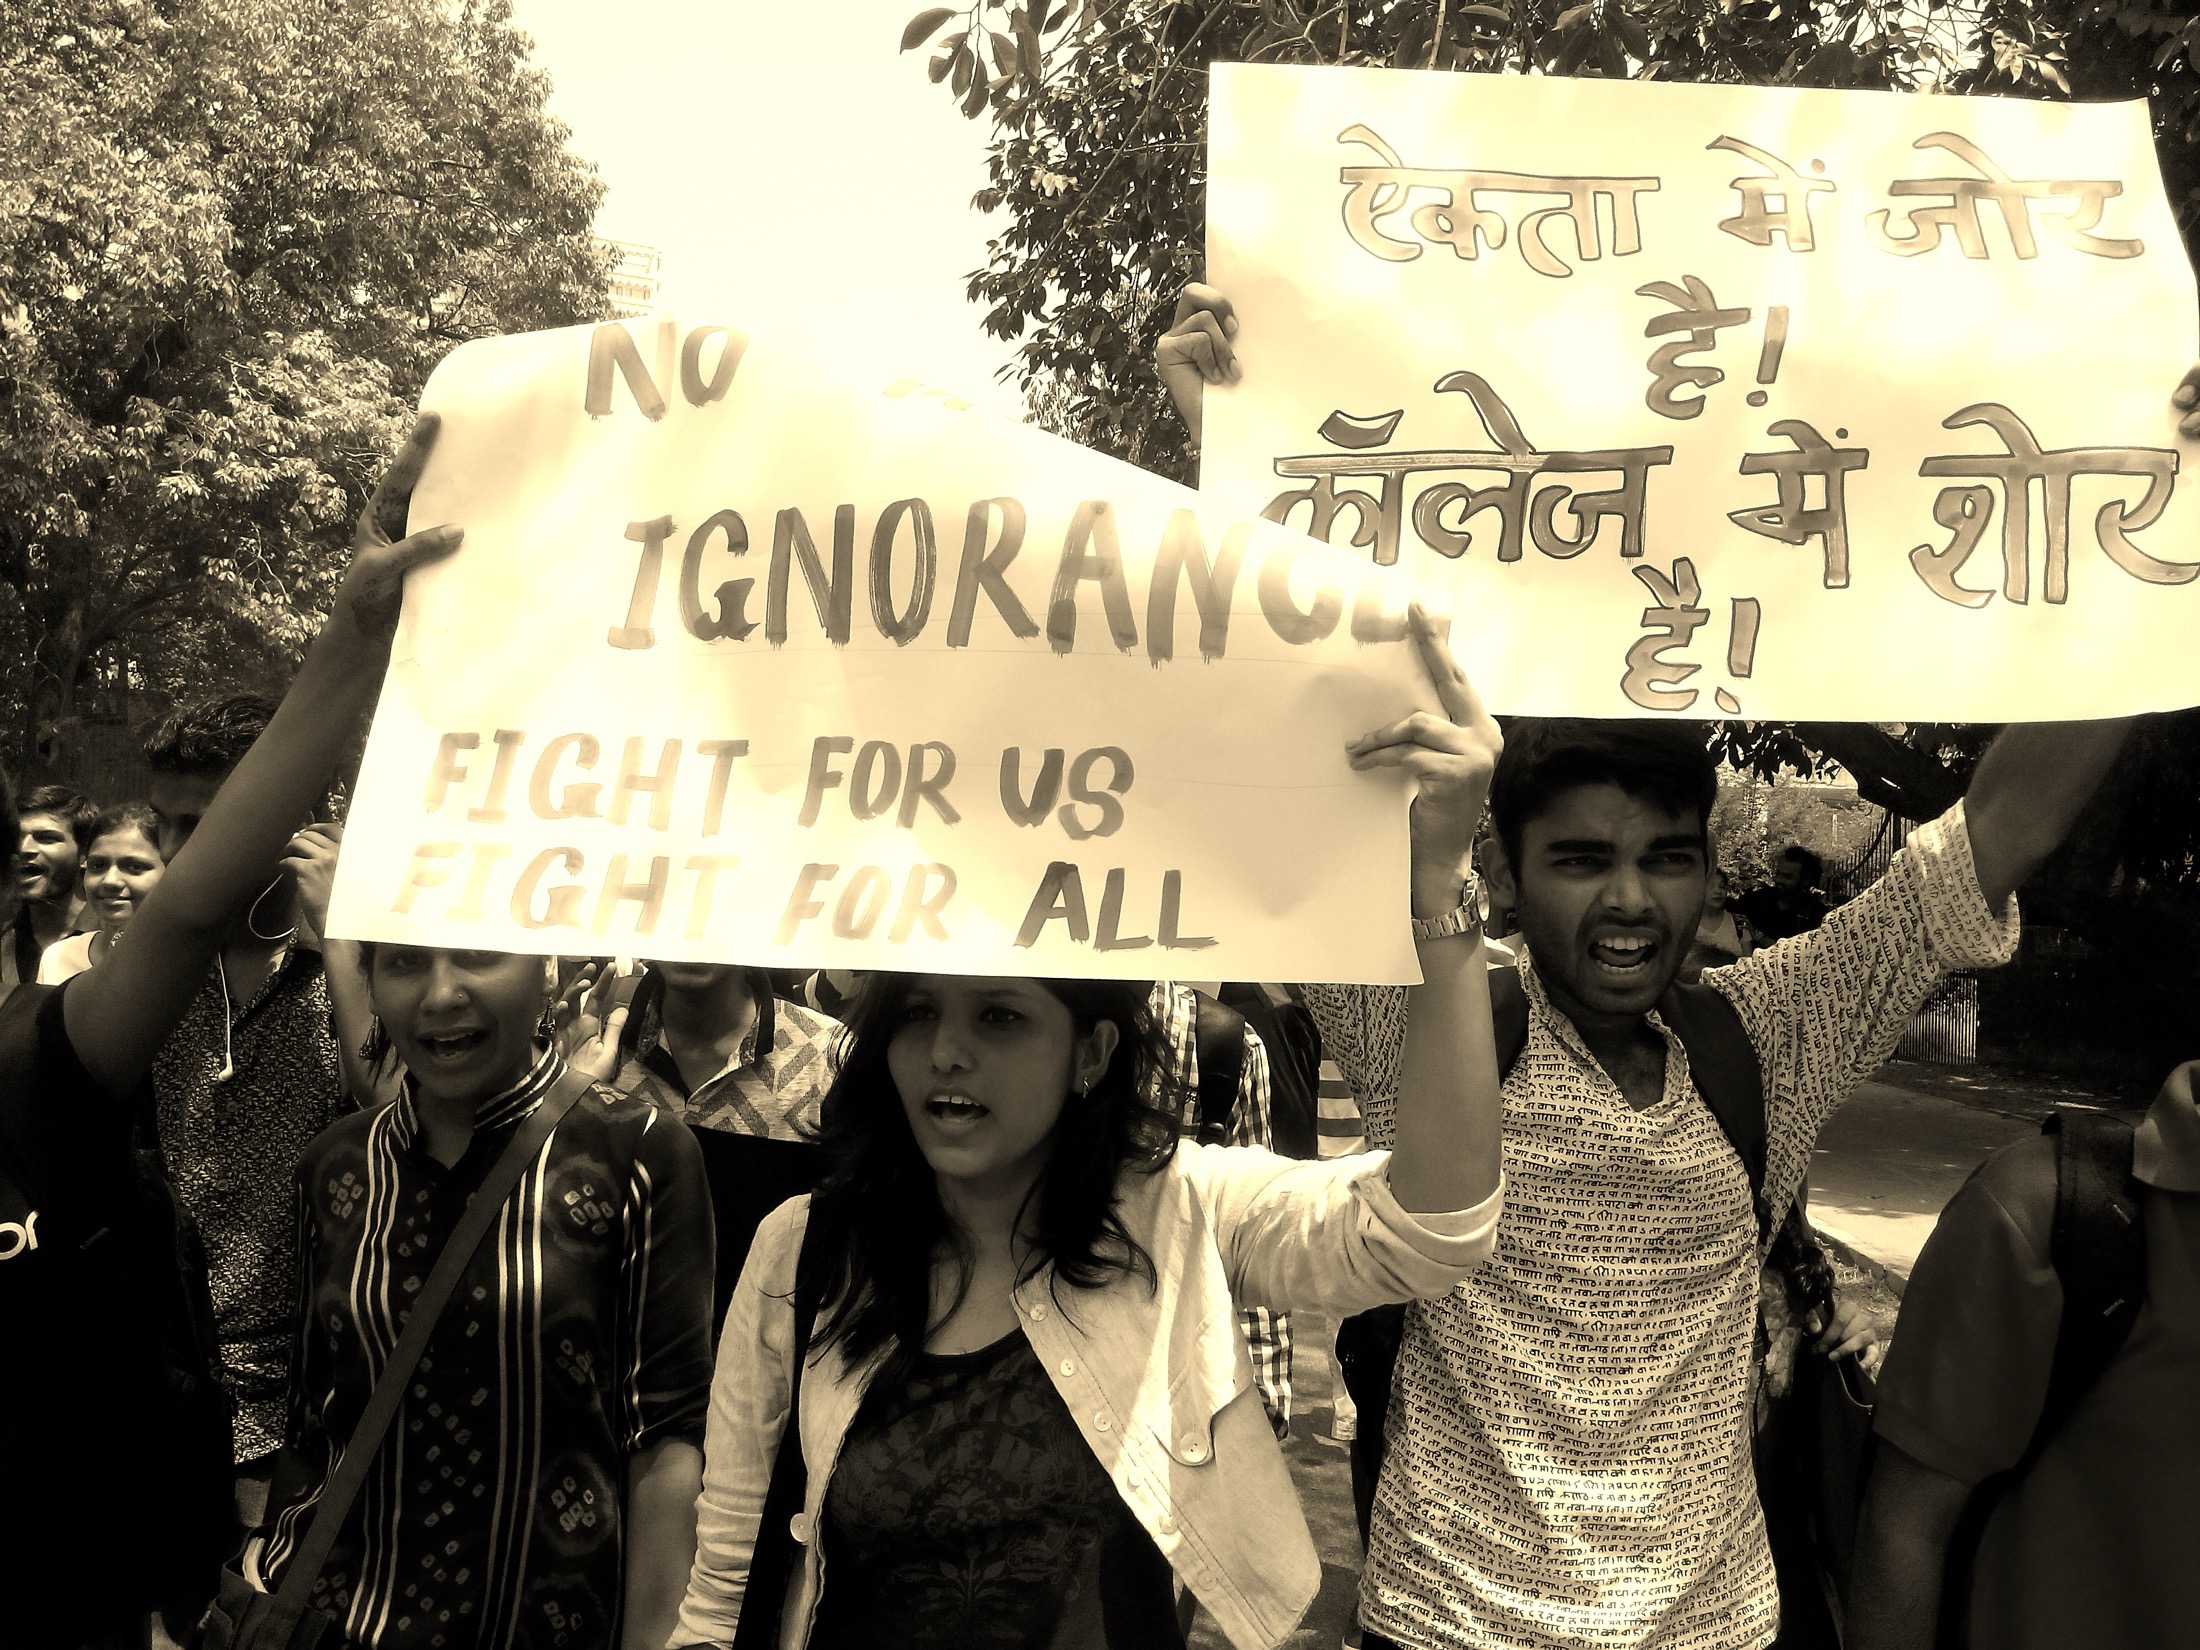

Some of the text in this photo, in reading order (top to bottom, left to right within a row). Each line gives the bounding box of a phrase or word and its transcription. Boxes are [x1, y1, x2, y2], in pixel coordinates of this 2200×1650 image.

[1706, 134, 1837, 253] में
[1865, 131, 2145, 260] जोर
[585, 321, 749, 421] NO
[1259, 370, 2200, 610] कॉलेज में शोर
[424, 728, 1135, 841] FIGHT FOR US
[390, 841, 1219, 952] FIGHT FOR ALL
